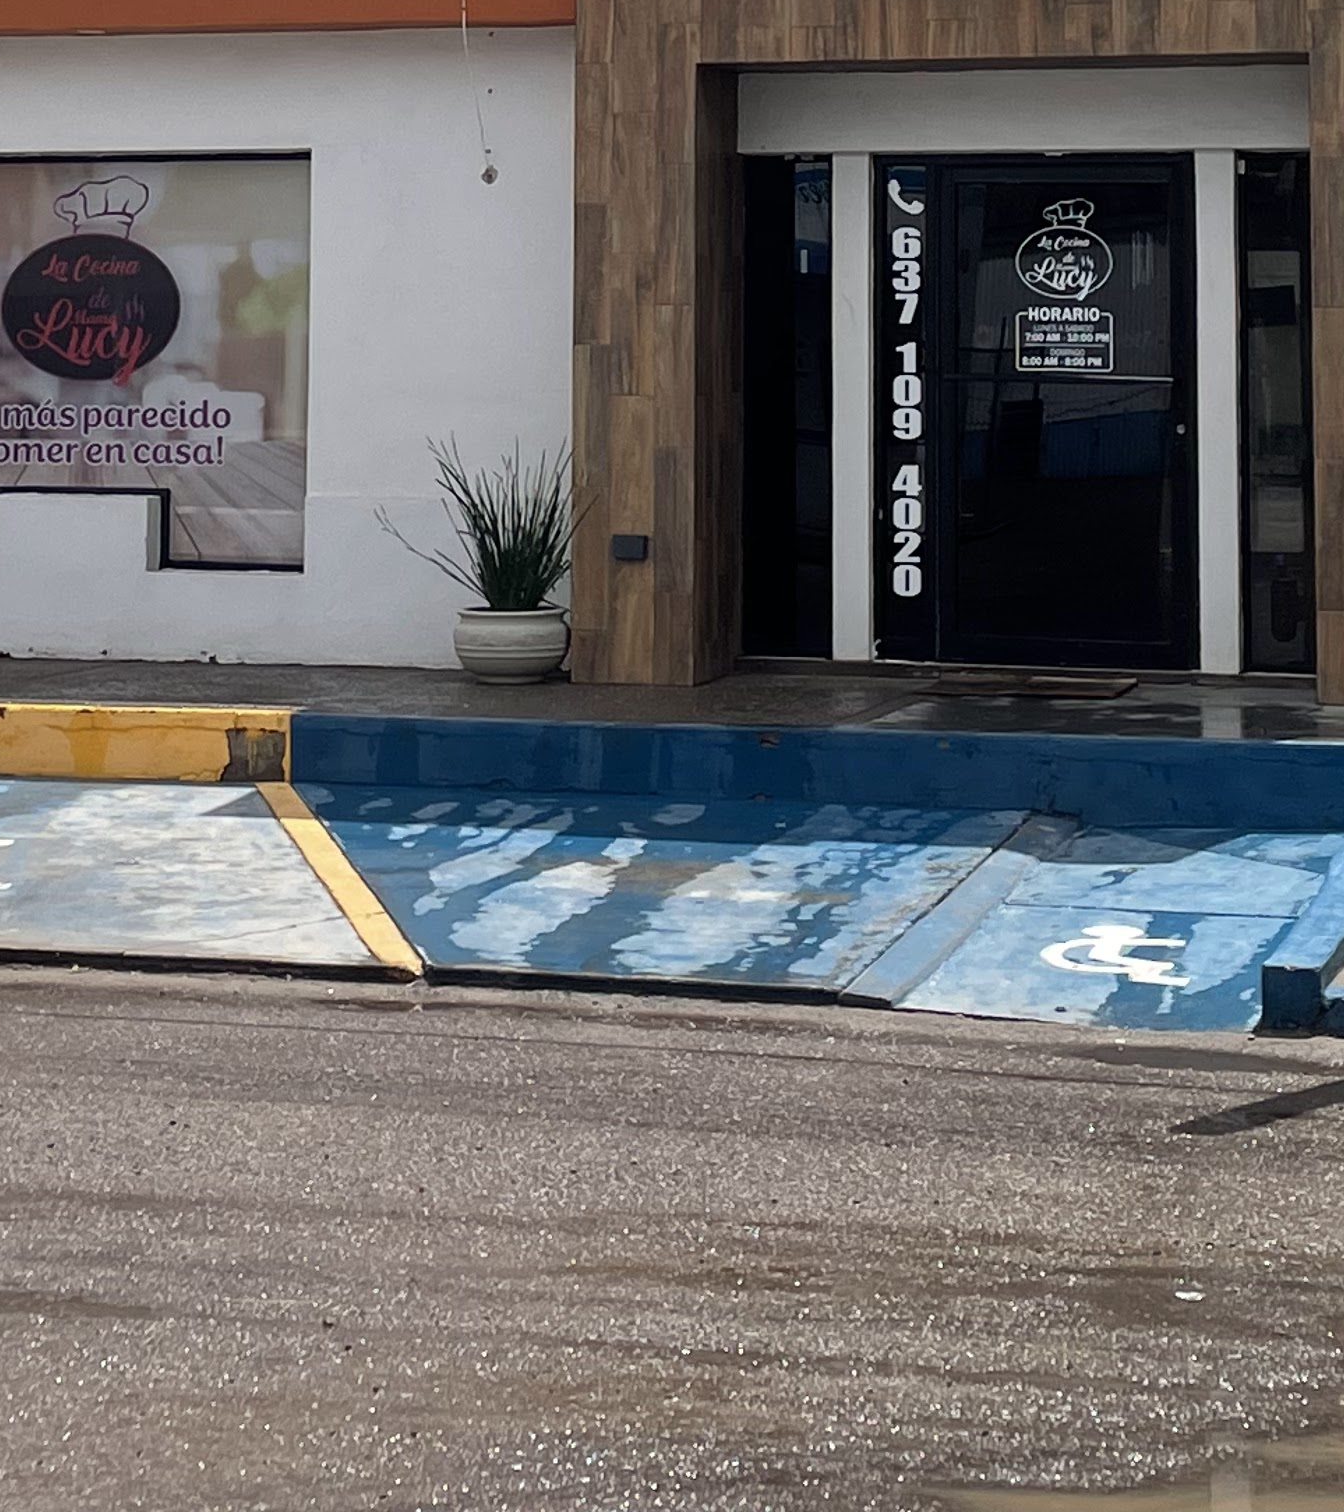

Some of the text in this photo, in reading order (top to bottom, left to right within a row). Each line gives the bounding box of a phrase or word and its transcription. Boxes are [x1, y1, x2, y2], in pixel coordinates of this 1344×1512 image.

[1054, 236, 1090, 251] Cocina
[41, 254, 140, 282] La Cocina
[1025, 256, 1098, 301] Lucy
[89, 287, 111, 308] de
[1028, 306, 1101, 322] HORARIO
[16, 298, 152, 386] Lucy
[1046, 333, 1061, 342] AM
[1095, 333, 1110, 342] PM
[1043, 356, 1058, 366] AM
[1087, 356, 1103, 366] PM
[3, 398, 75, 429] más
[83, 399, 232, 435] parecido
[892, 227, 922, 597] 637 109 4020
[86, 442, 126, 465] en
[134, 435, 224, 466] casa!
